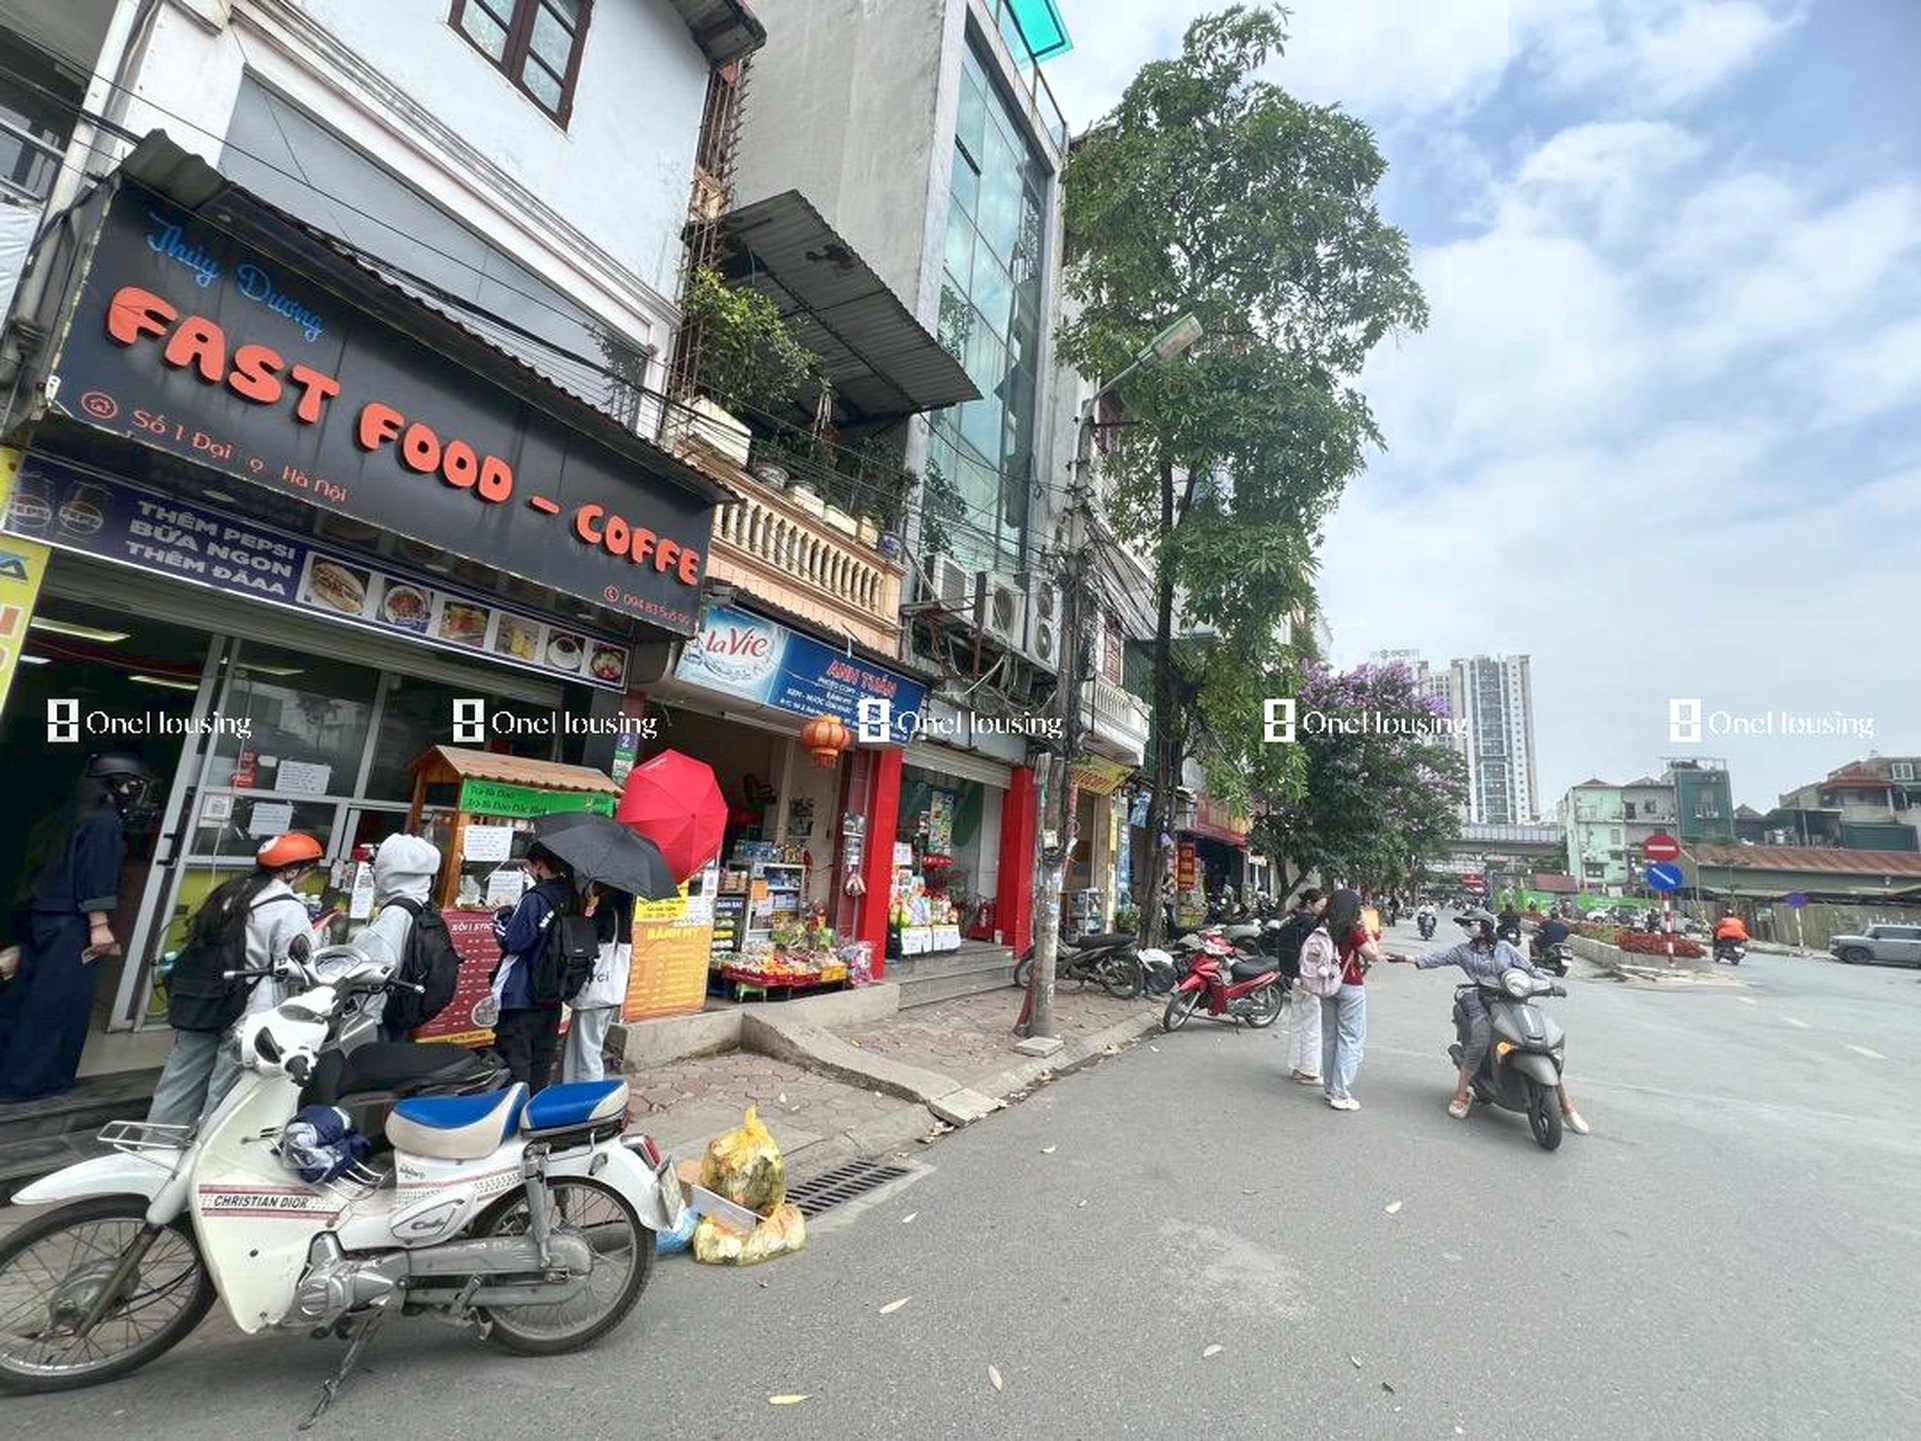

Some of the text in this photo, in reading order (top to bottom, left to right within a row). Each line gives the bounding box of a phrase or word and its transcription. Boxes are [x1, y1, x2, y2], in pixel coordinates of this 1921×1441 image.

[108, 285, 341, 424] FAST
[360, 402, 513, 502] FOOD
[577, 504, 699, 586] COFFE
[132, 410, 166, 433] Số
[192, 431, 232, 460] Đại
[129, 519, 293, 577] BỮA NGON
[138, 500, 218, 536] THÊM
[224, 527, 296, 560] PEPSI
[125, 541, 205, 573] THÊM
[622, 734, 631, 748] 2
[213, 1195, 309, 1209] CHRISTIAN DIOR
